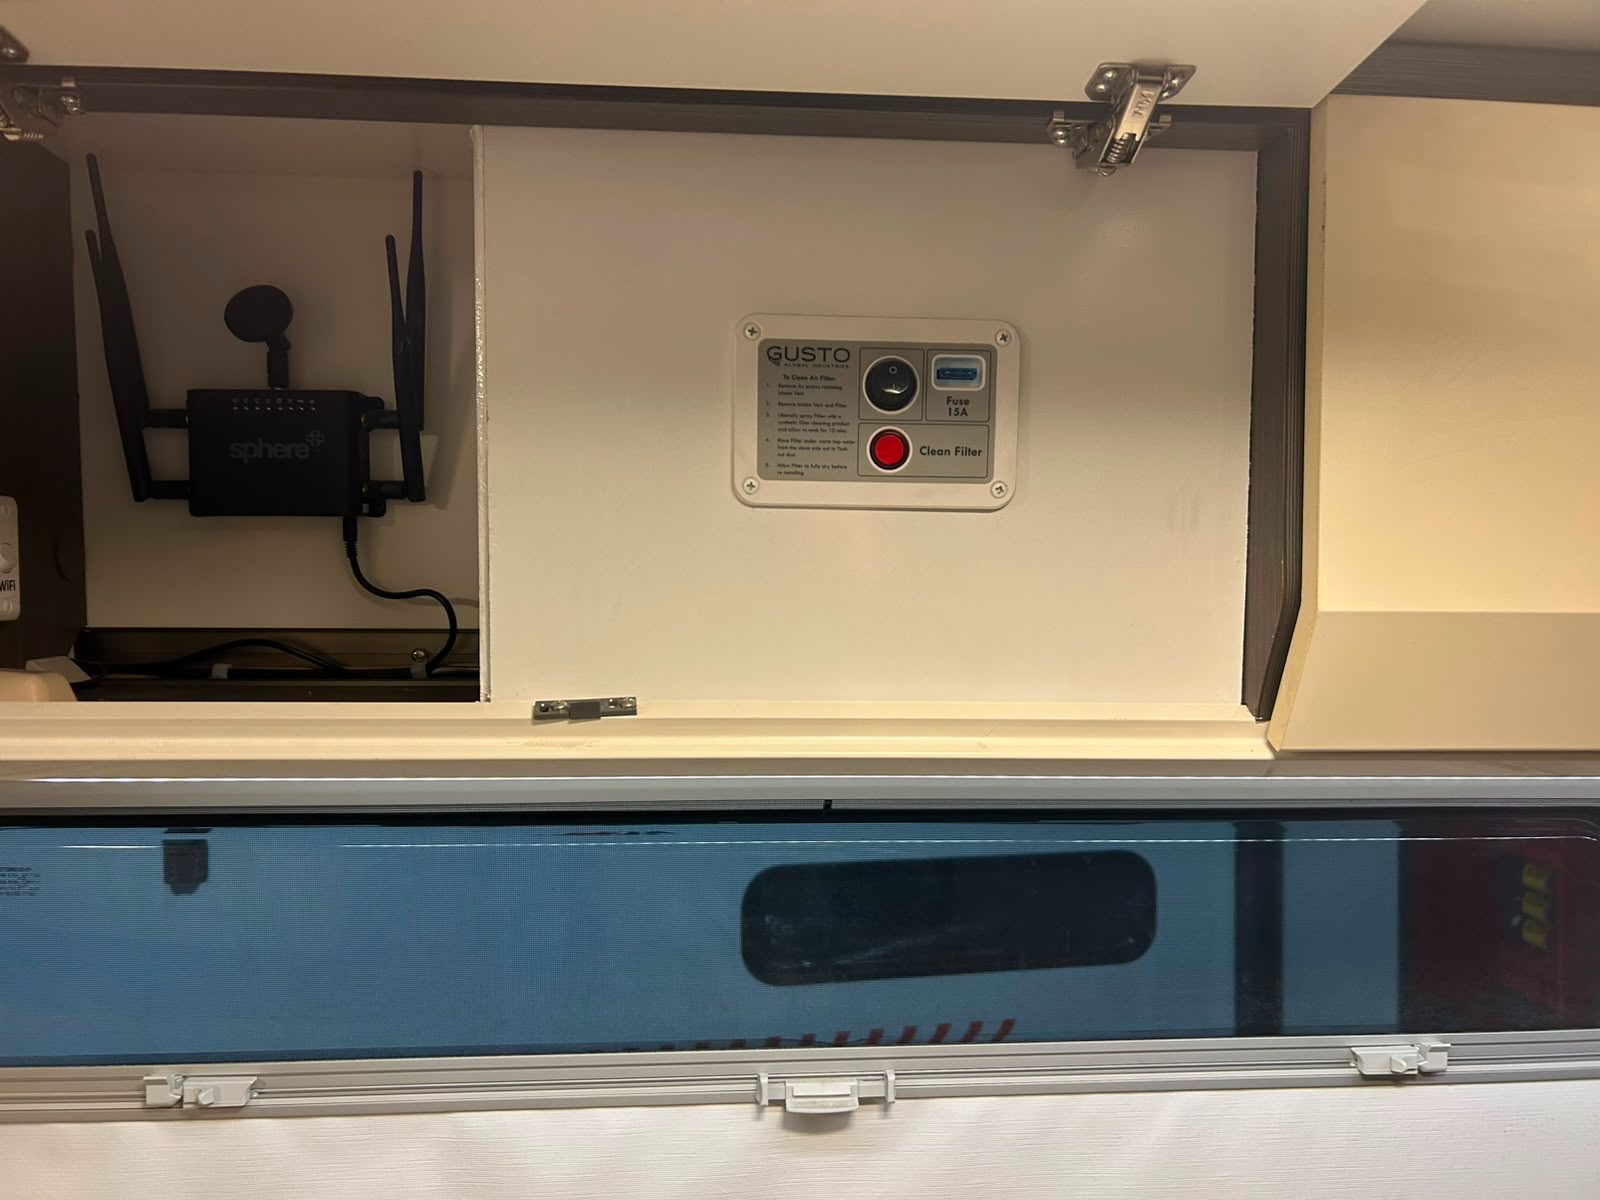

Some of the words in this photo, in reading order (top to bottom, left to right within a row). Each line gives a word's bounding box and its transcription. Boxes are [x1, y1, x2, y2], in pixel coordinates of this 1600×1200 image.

[766, 345, 851, 363] GUSTO
[946, 396, 970, 406] Fuse
[947, 407, 969, 417] 15A
[229, 436, 311, 464] sphere
[919, 445, 951, 456] Clean
[954, 446, 983, 457] Filter
[0, 579, 16, 592] WiFi
